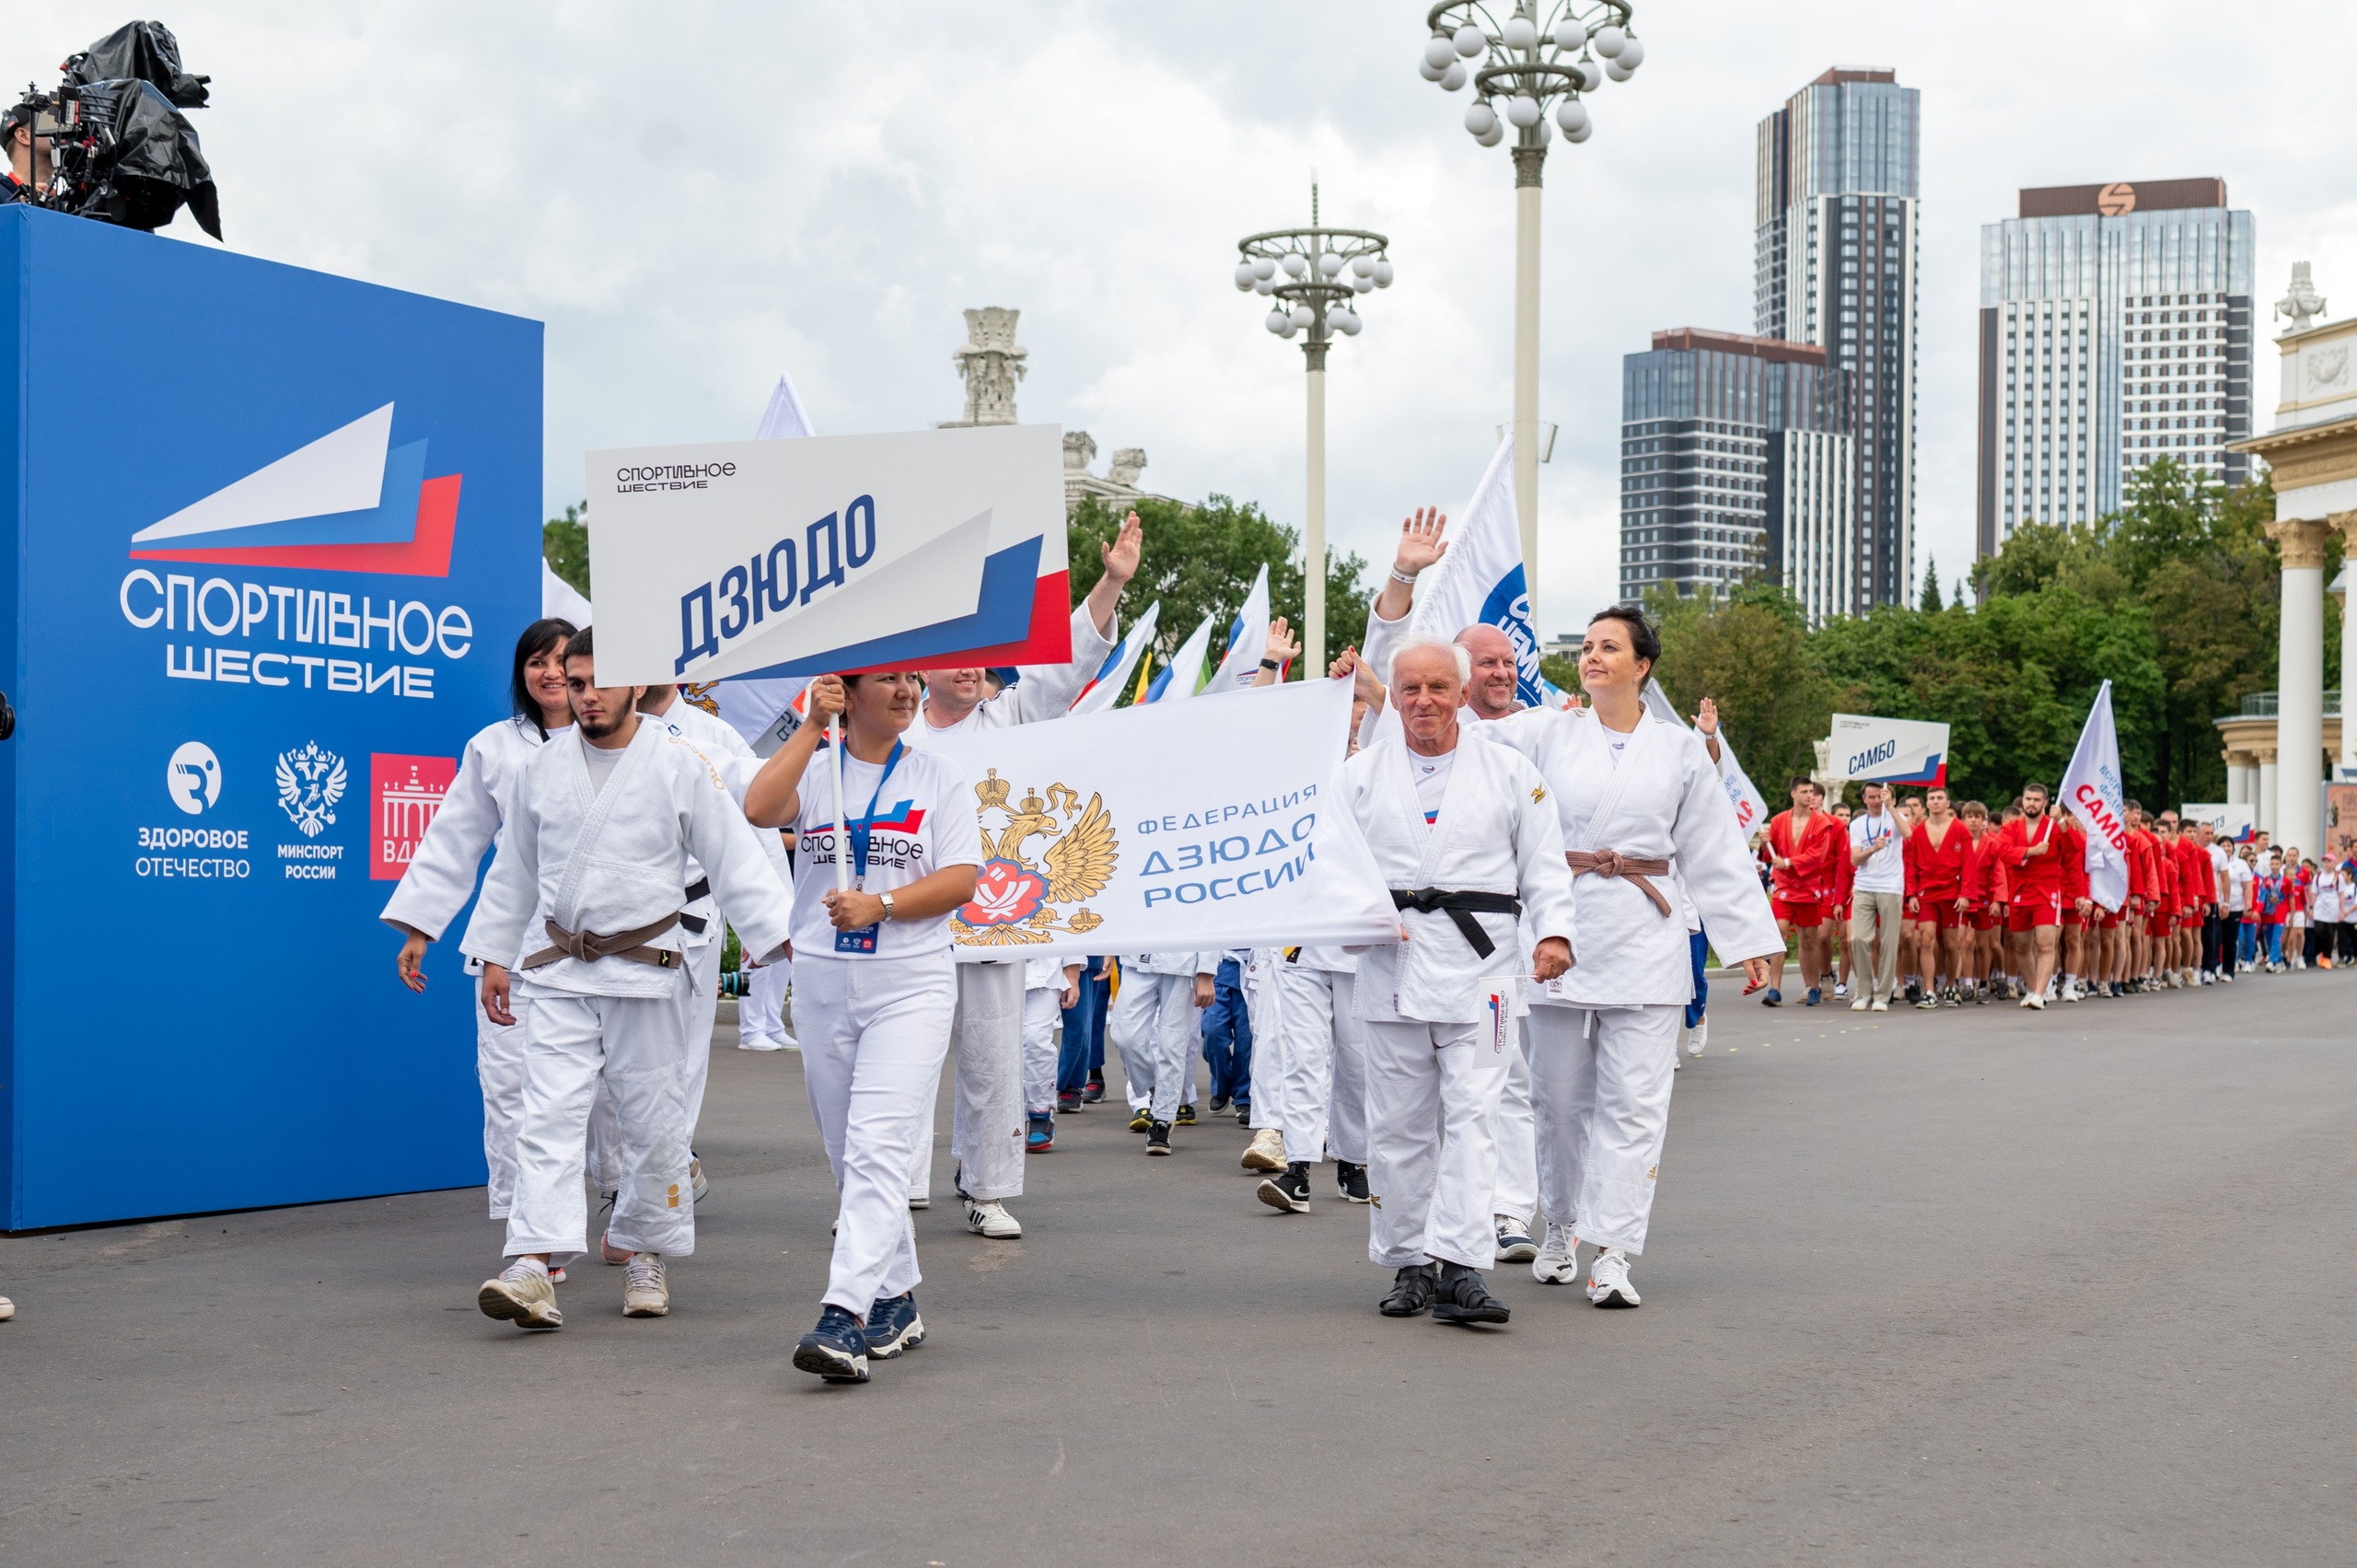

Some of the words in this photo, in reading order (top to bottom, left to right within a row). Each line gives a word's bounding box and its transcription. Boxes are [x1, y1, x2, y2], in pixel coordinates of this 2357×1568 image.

[617, 480, 708, 494] ШЕСТВИЕ
[674, 494, 877, 677] ДЗЮДО
[166, 644, 435, 700] ШЕСТВИЕ
[1848, 739, 1896, 775] САМБО
[1137, 783, 1318, 835] ФЕДЕРАЦИЯ
[138, 827, 250, 851] ЗДОРОВОЕ
[277, 843, 344, 860] МИНСПОРТ
[1139, 812, 1317, 877] ДЗЮДО
[135, 857, 250, 878] ОТЕЧЕСТВО
[285, 865, 336, 880] РОССИИ
[1144, 842, 1316, 909] РОССИИ
